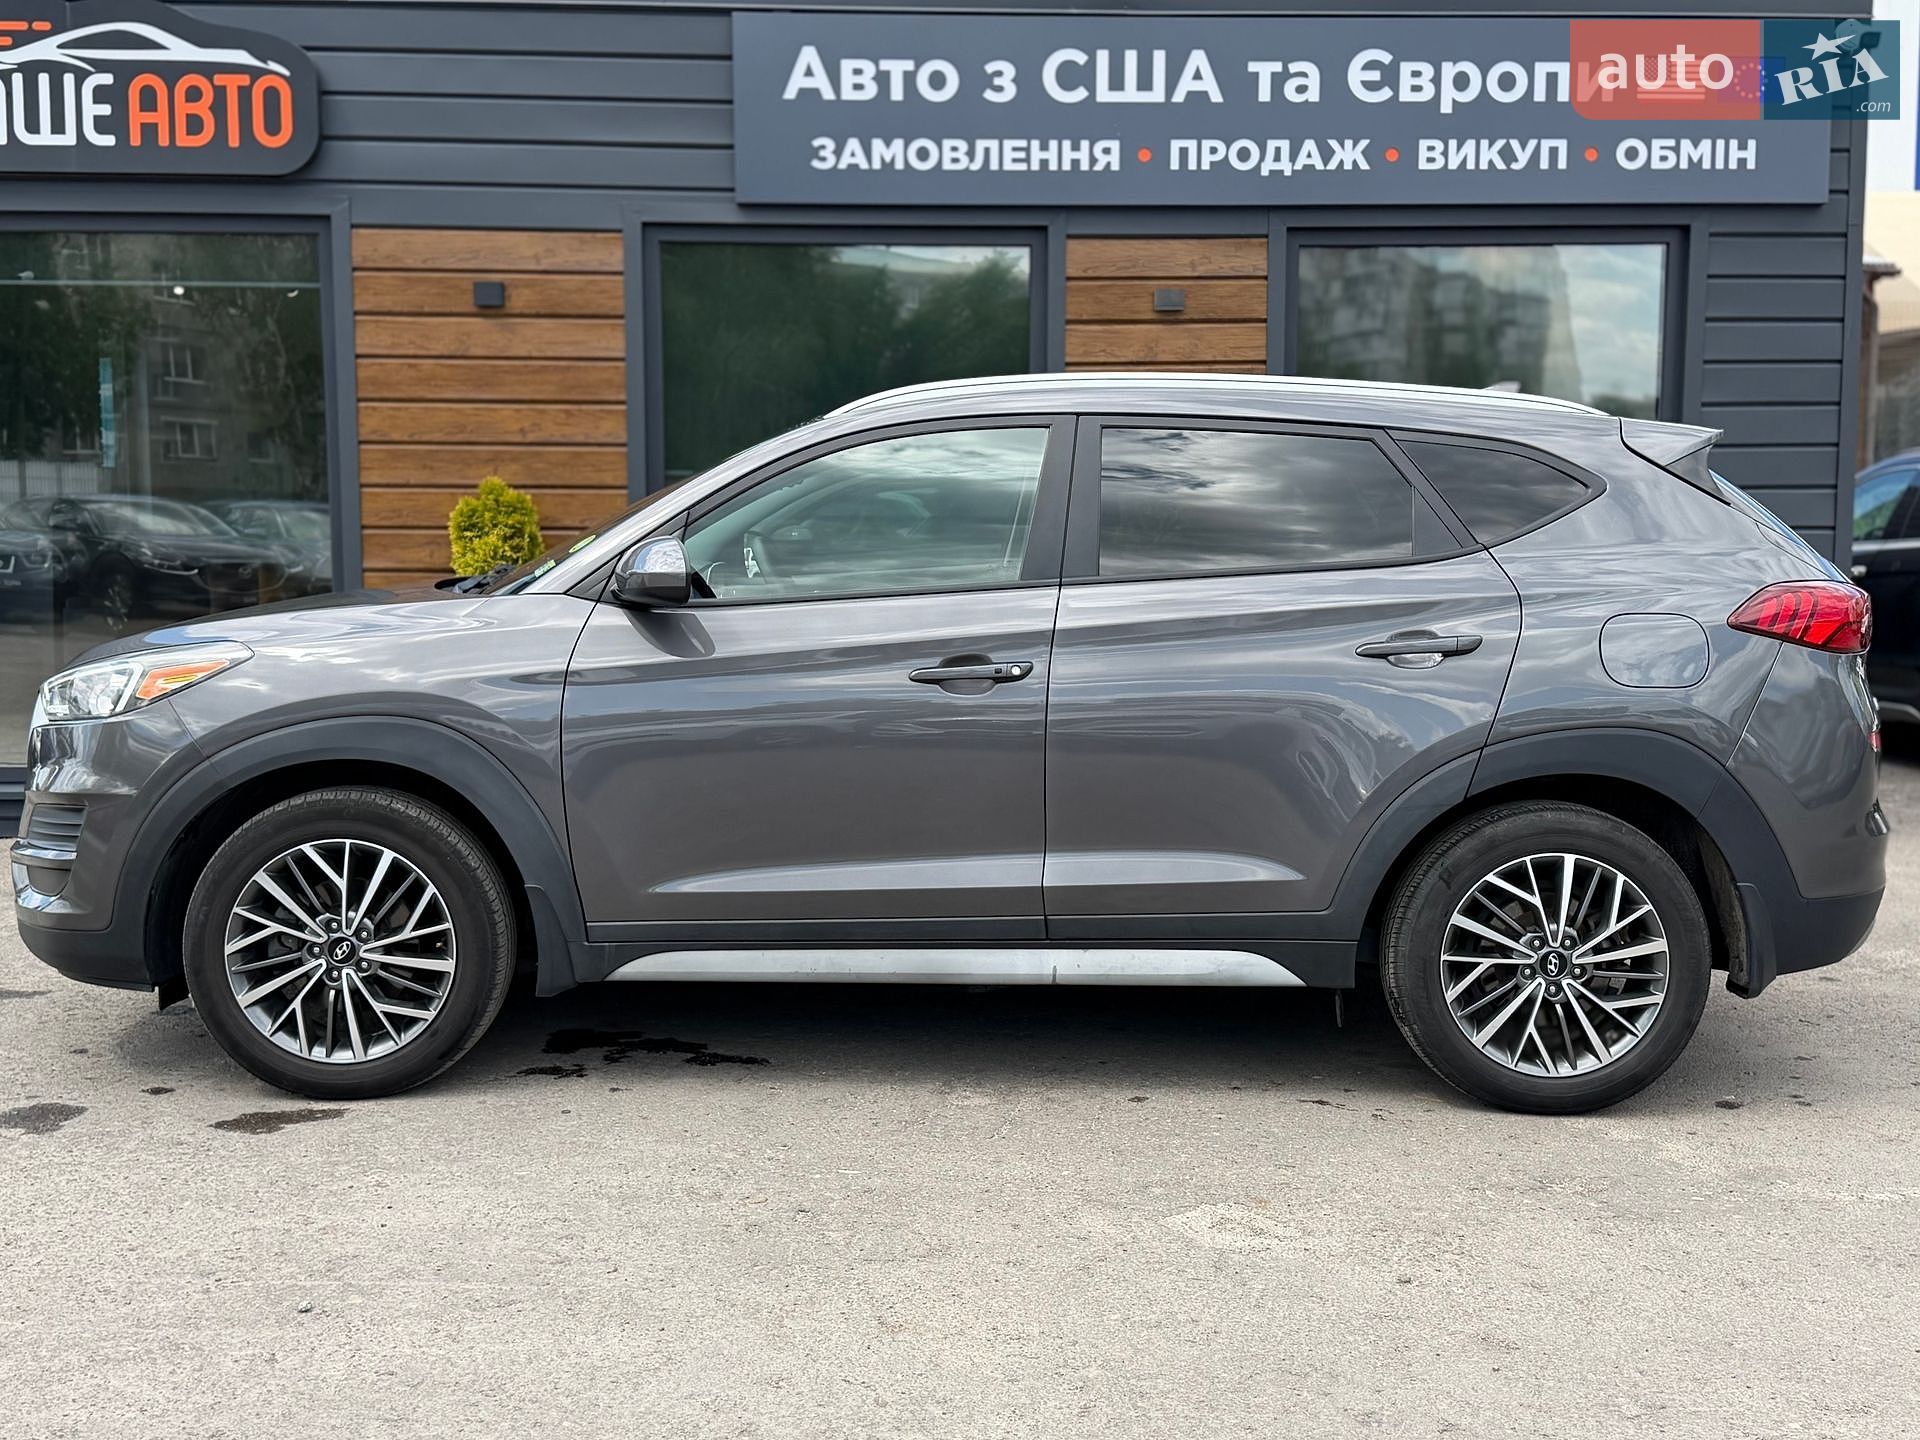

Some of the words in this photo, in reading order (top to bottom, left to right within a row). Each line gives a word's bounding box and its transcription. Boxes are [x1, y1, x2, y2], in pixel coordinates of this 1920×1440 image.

[782, 45, 960, 103] Авто
[982, 60, 1017, 103] з
[1042, 48, 1224, 104] США
[1247, 60, 1322, 104] та
[0, 72, 116, 147] ШЕ
[128, 73, 293, 148] АВТО
[810, 136, 1120, 171] ЗАМОВЛЕННЯ
[1169, 138, 1371, 177] ПРОДАЖ
[1417, 138, 1569, 171] ВИКУП
[1615, 137, 1757, 171] ОБМІН
